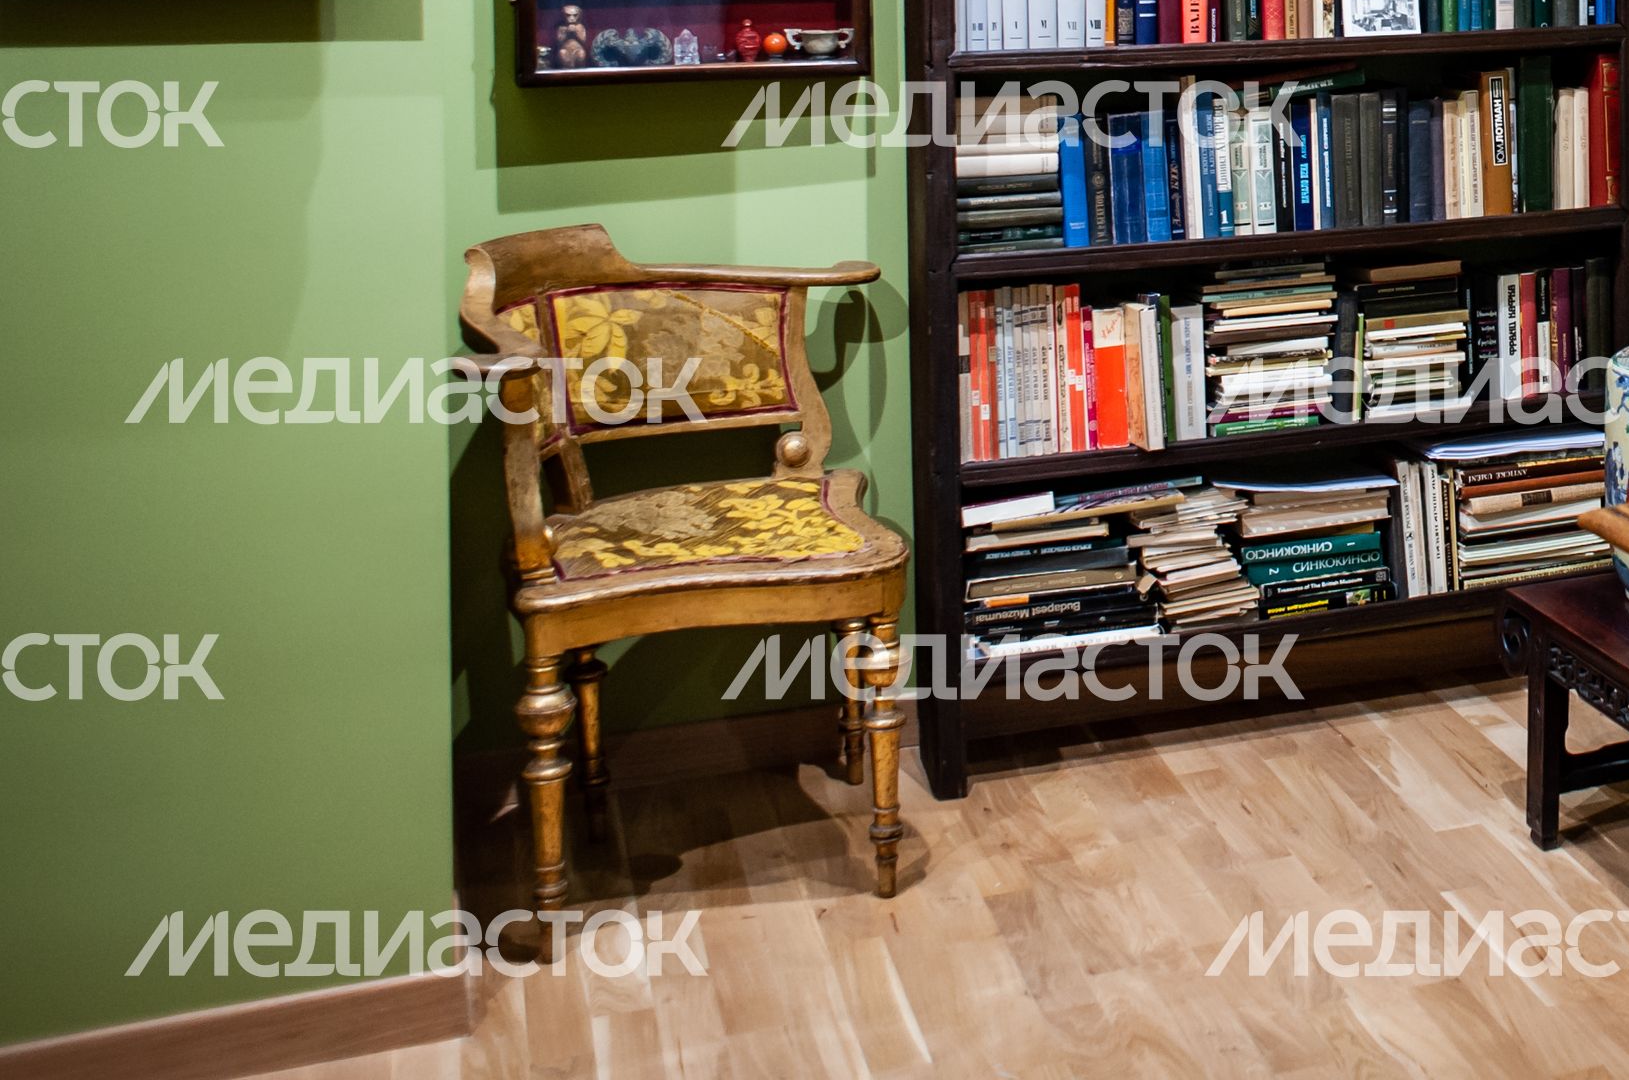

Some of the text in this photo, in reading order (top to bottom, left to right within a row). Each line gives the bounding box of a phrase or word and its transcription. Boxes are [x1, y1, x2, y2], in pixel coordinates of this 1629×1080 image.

[1214, 105, 1226, 152] АНДРЕЕВ
[1300, 163, 1309, 178] ВЕКА
[1300, 179, 1310, 204] НАЧАЛО
[1507, 285, 1517, 356] ФРАНЦ КАФКА
[1246, 541, 1333, 561] СИНКОКИНСЮ
[1292, 551, 1380, 574] СИНКОКИНСЮ
[1032, 601, 1081, 617] Budapest
